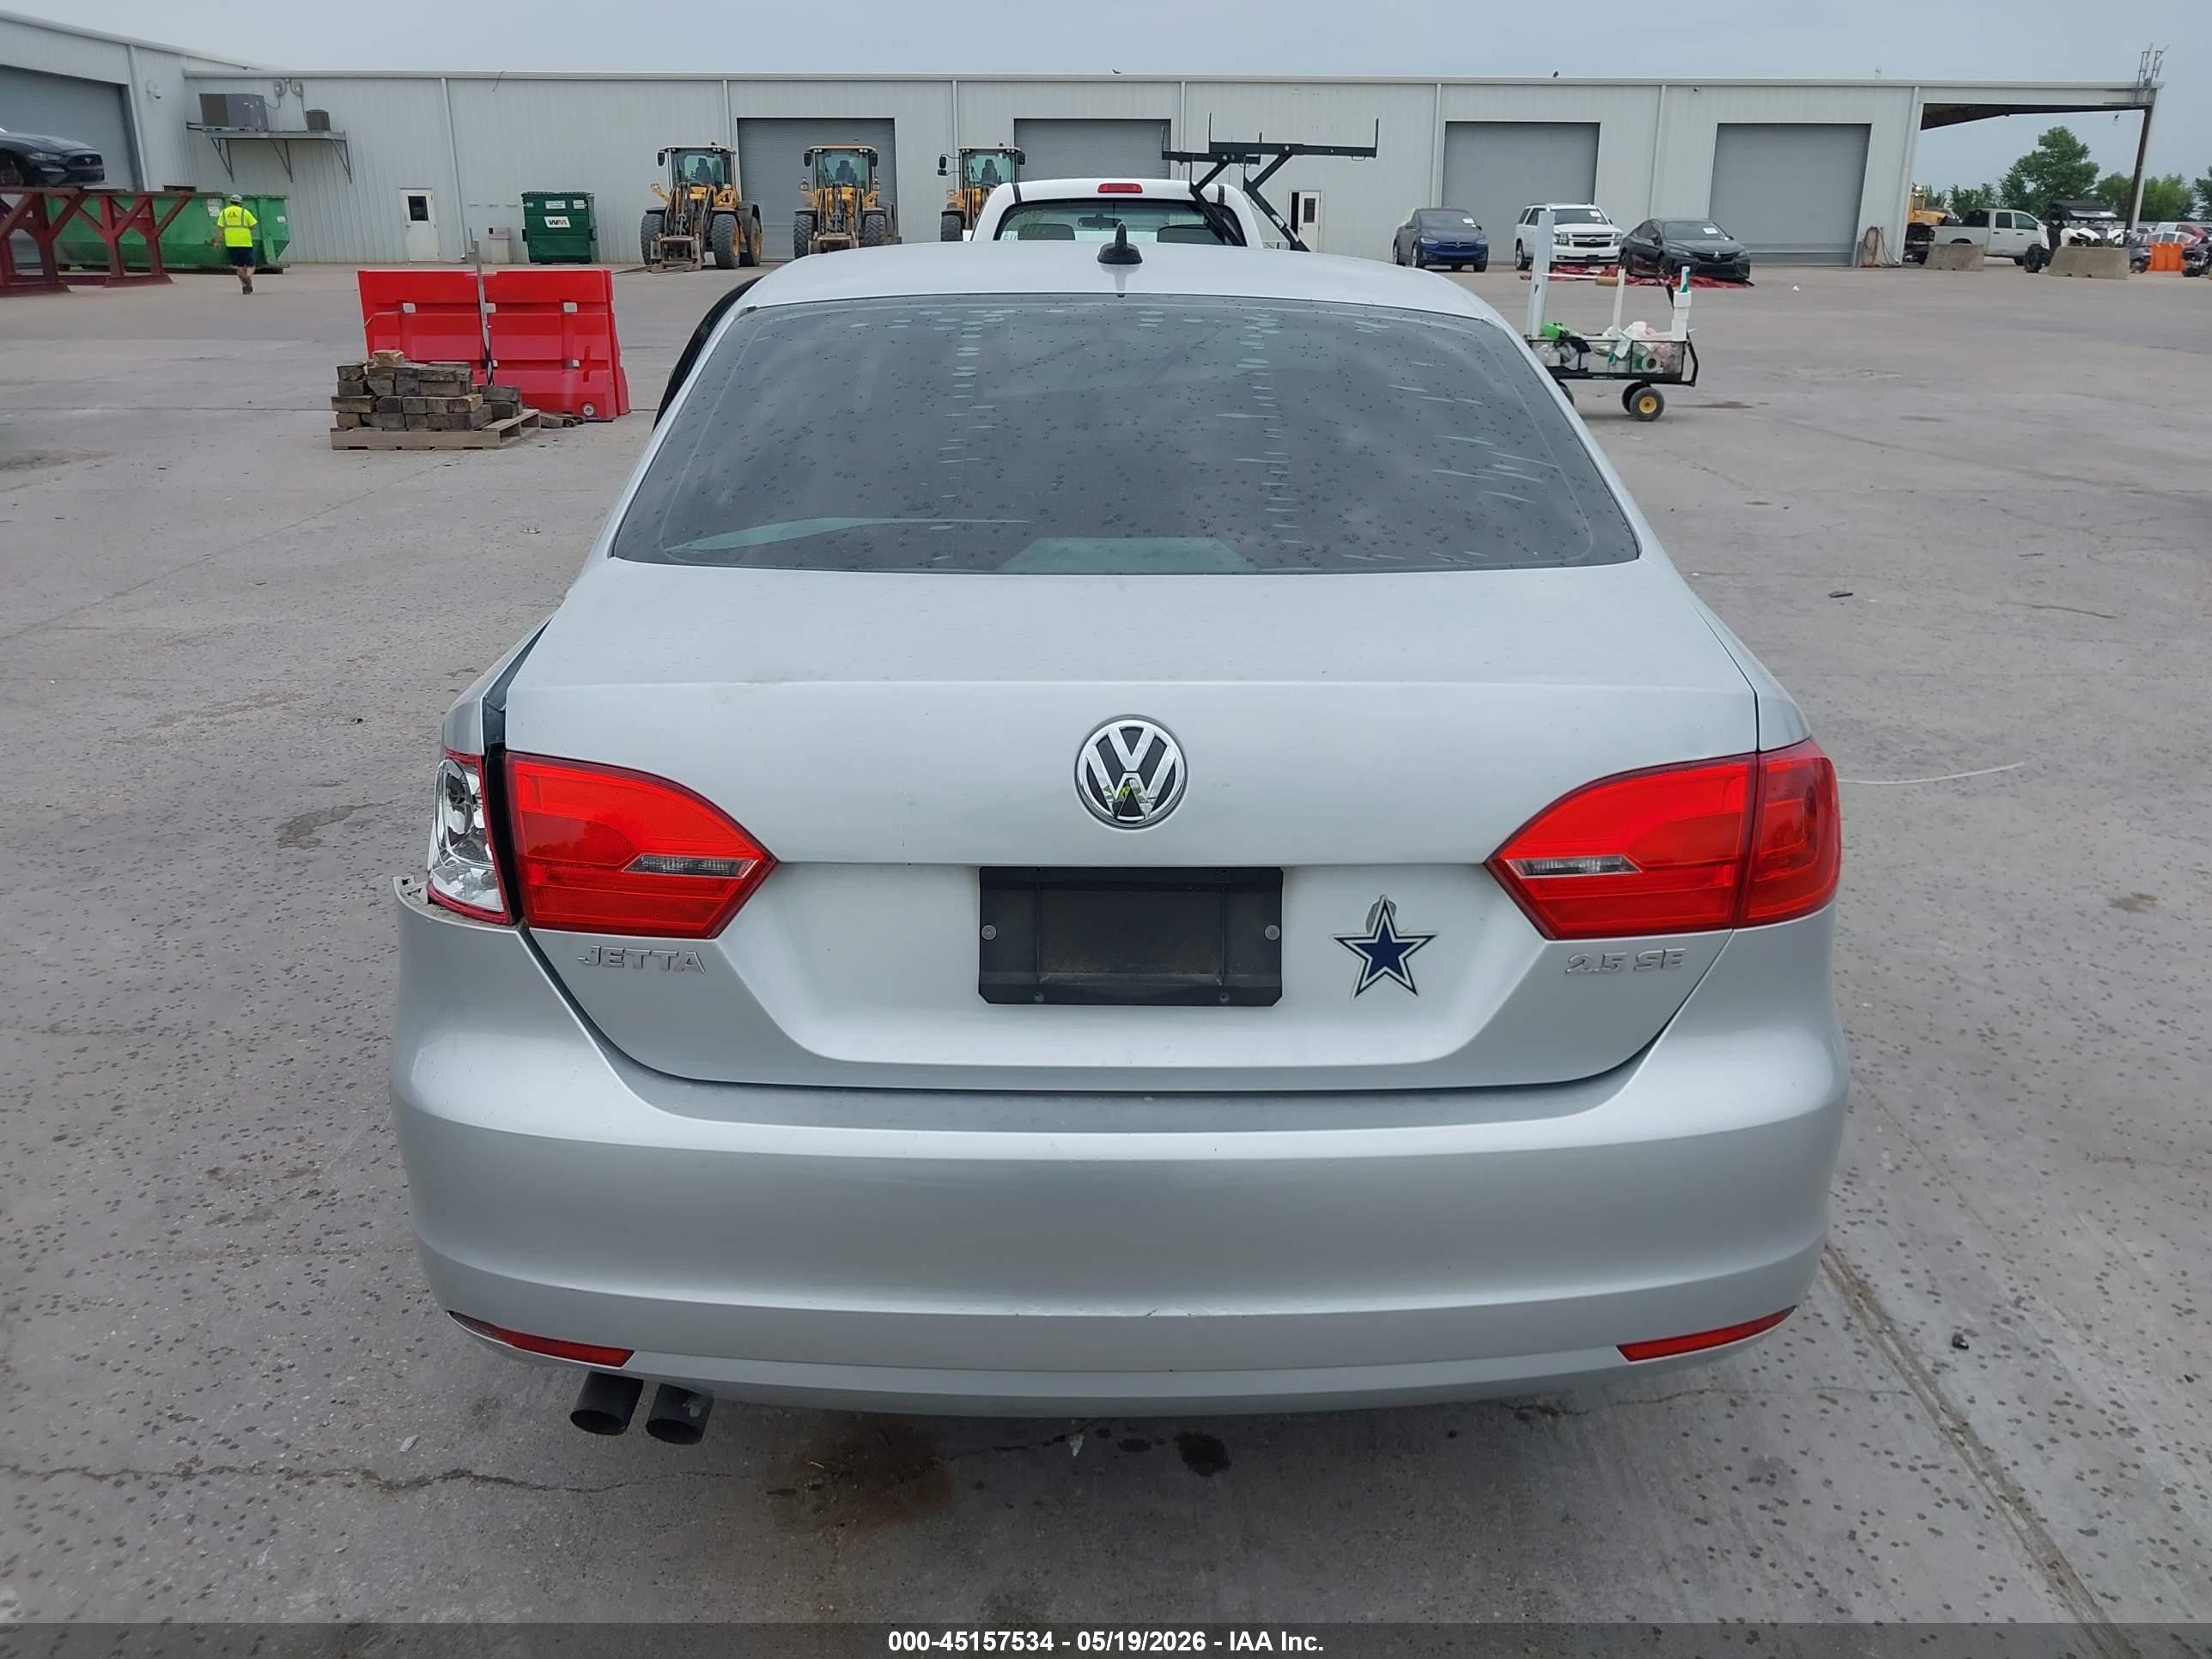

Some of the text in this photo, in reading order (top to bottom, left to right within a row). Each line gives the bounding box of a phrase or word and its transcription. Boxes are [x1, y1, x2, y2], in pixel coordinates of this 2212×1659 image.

[1081, 723, 1180, 821] VW
[576, 945, 706, 974] JETTA
[1565, 947, 1686, 975] 2.5 SE
